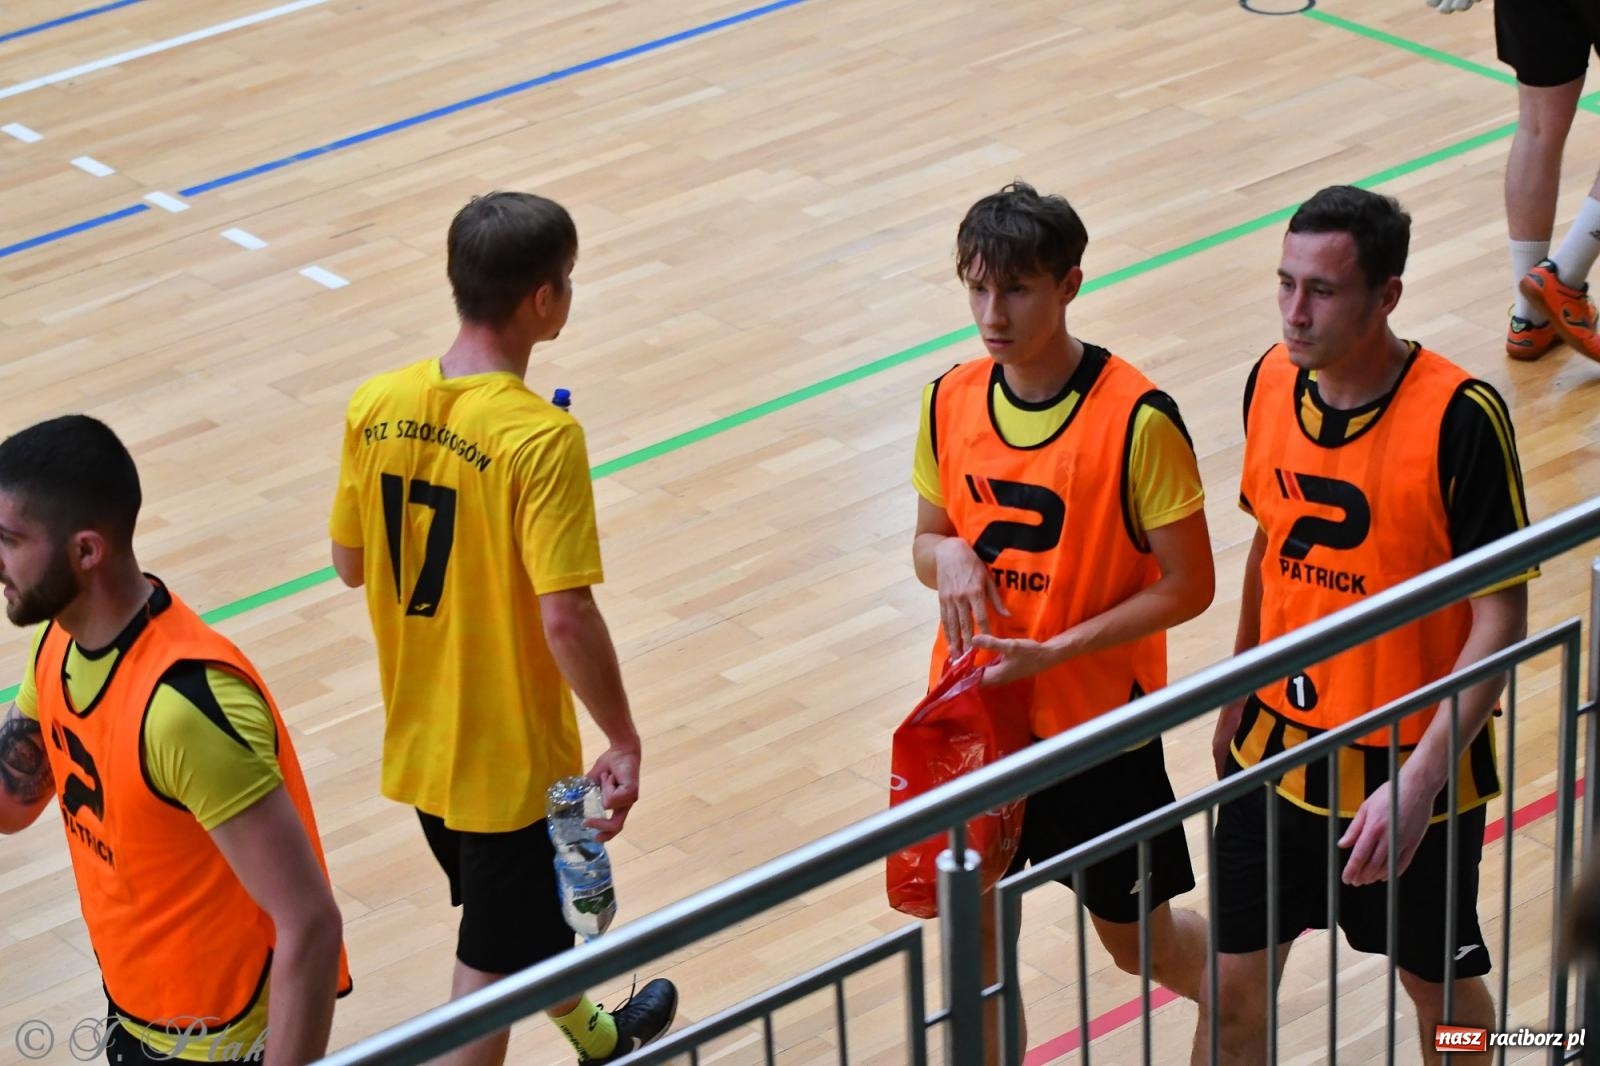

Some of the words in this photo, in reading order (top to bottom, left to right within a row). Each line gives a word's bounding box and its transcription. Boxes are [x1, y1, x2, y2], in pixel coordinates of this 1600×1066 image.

[381, 472, 456, 617] 17
[1279, 558, 1367, 595] PATRICK
[1293, 676, 1305, 708] 1
